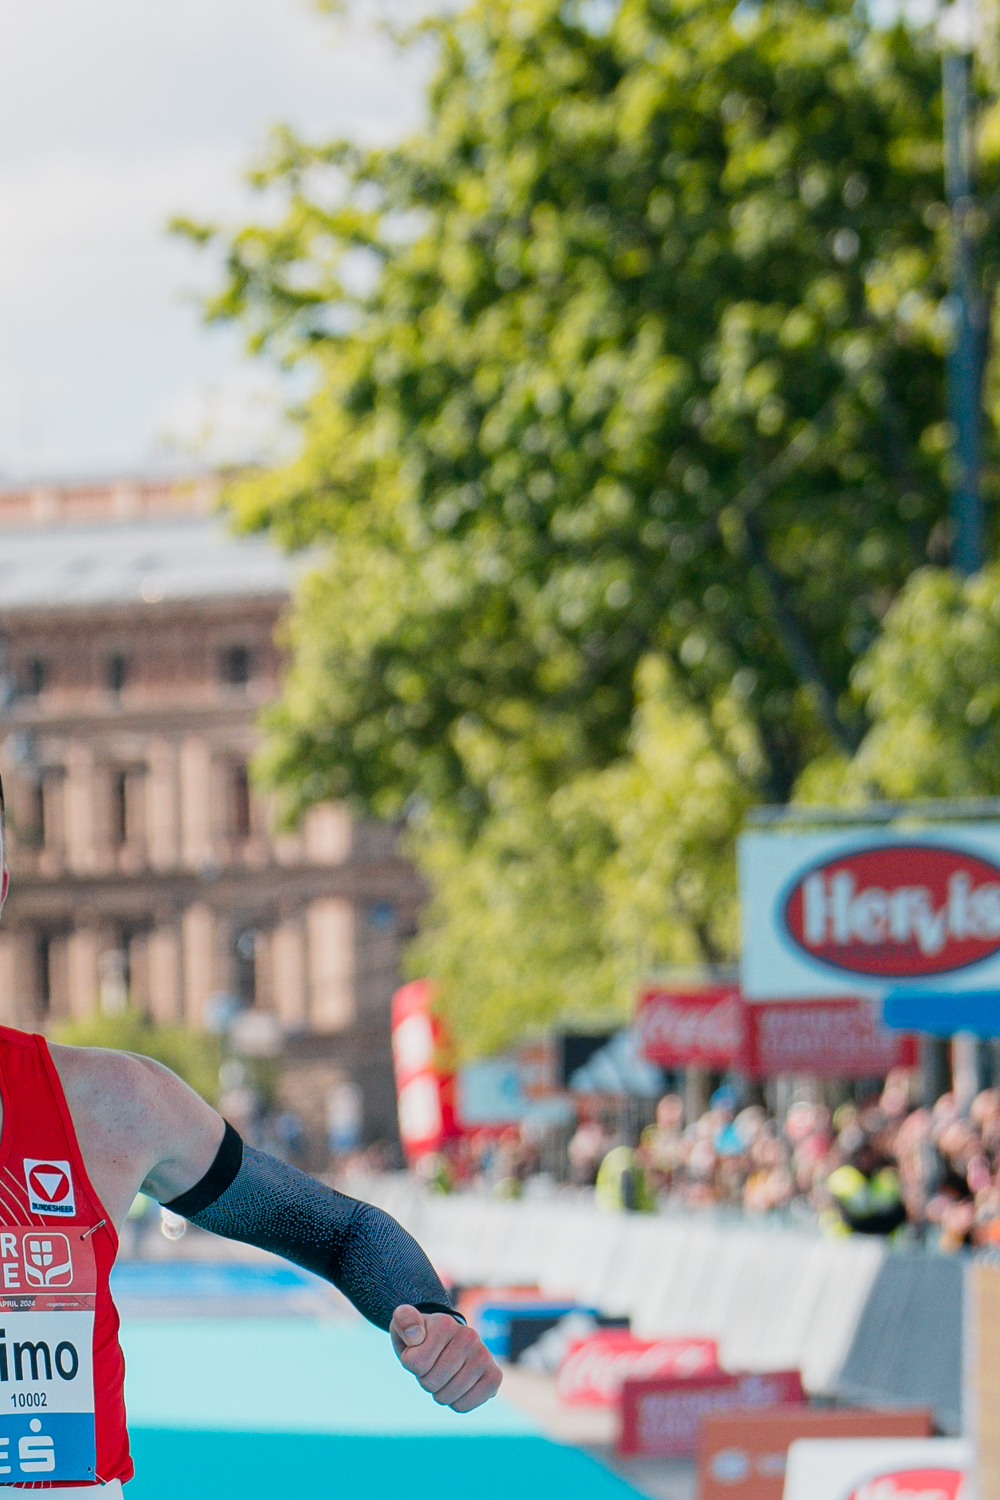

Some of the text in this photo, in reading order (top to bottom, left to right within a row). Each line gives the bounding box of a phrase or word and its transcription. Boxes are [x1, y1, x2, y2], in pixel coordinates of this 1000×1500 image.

[31, 1202, 74, 1213] BUNDESHEER
[20, 1300, 36, 1308] 2024
[10, 1392, 48, 1408] 10002
